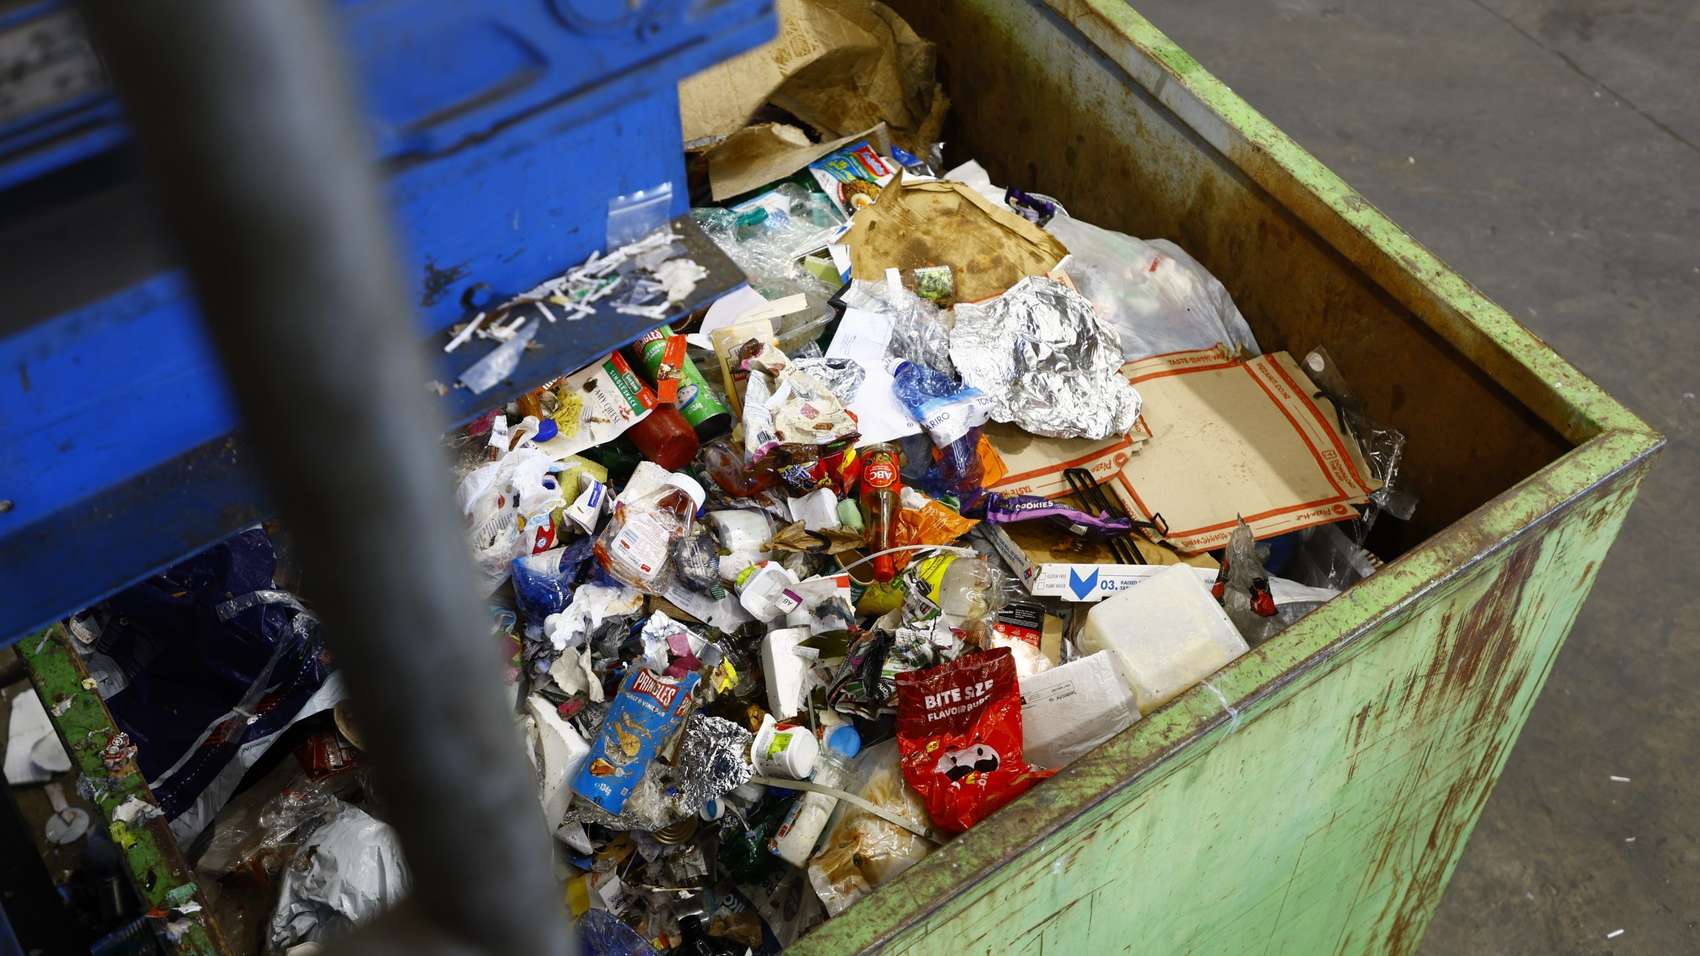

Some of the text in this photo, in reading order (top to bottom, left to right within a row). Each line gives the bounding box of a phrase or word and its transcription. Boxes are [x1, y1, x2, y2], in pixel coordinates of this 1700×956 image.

[870, 471, 893, 480] ABC
[1100, 580, 1118, 591] 03.
[633, 671, 676, 707] PRINGLES
[925, 687, 962, 710] BITE
